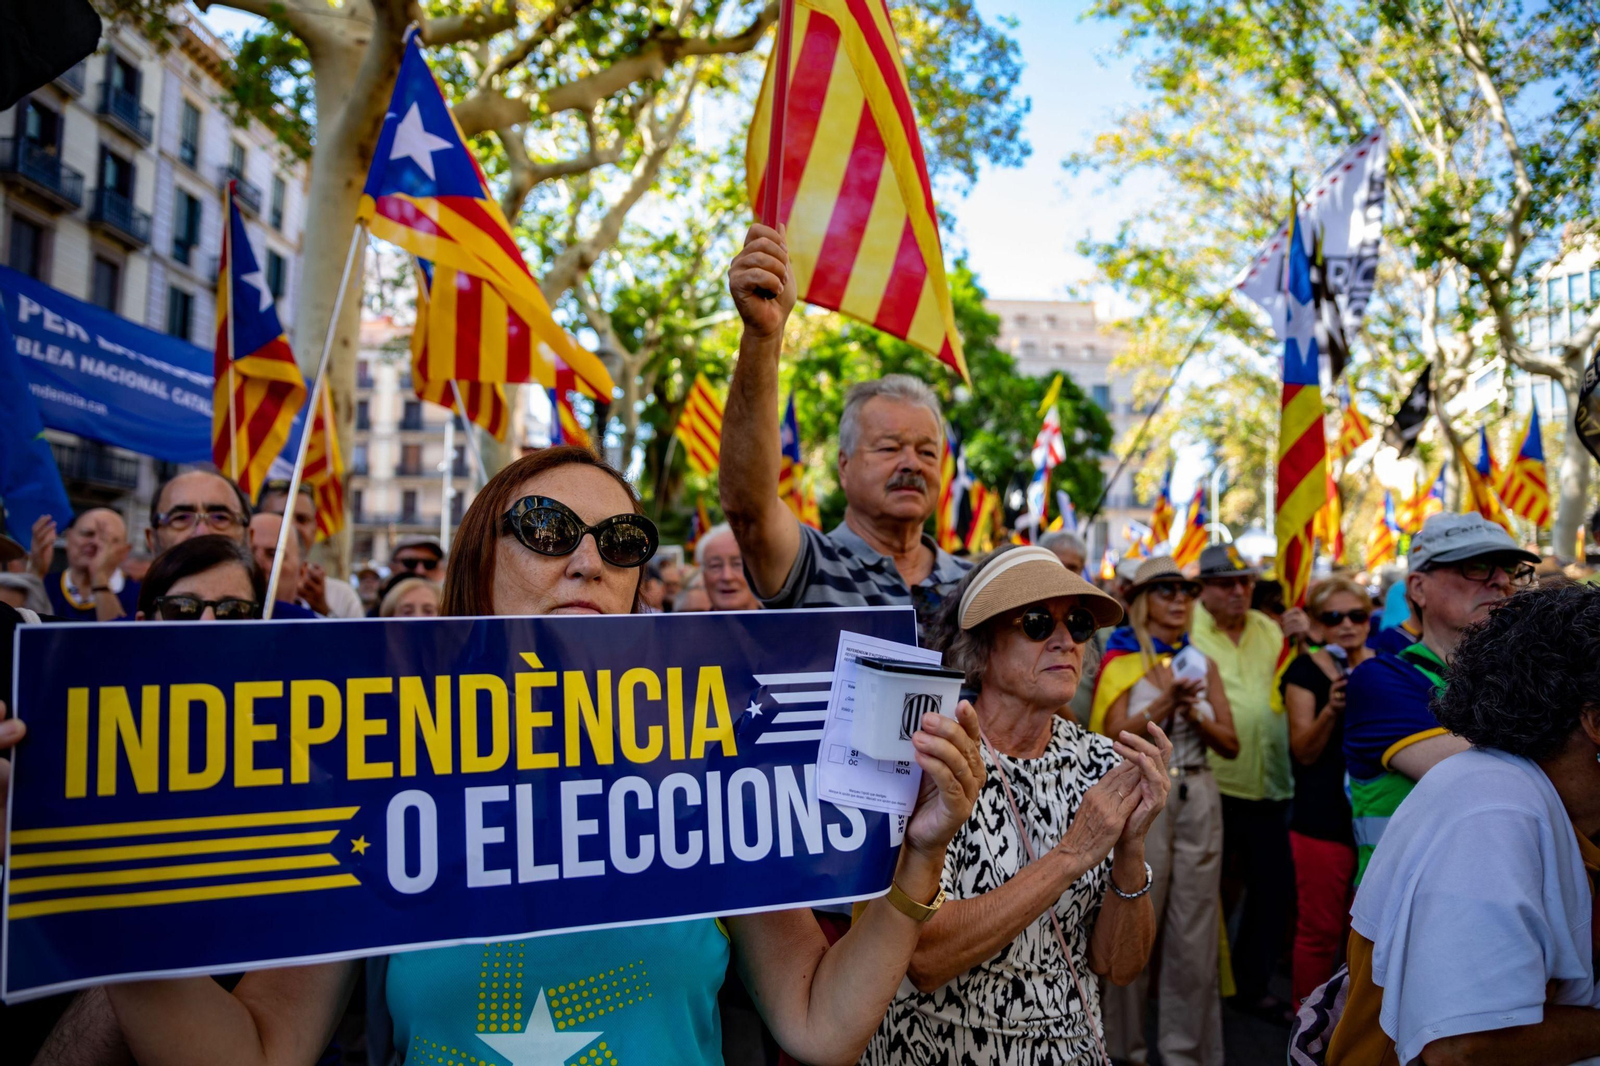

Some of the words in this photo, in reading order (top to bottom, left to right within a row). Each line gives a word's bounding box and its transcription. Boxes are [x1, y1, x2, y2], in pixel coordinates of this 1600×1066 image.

[13, 335, 76, 370] BLEA
[80, 355, 170, 400] NACIONAL
[65, 652, 738, 799] INDEPENDÈNCIA
[386, 789, 438, 895] O
